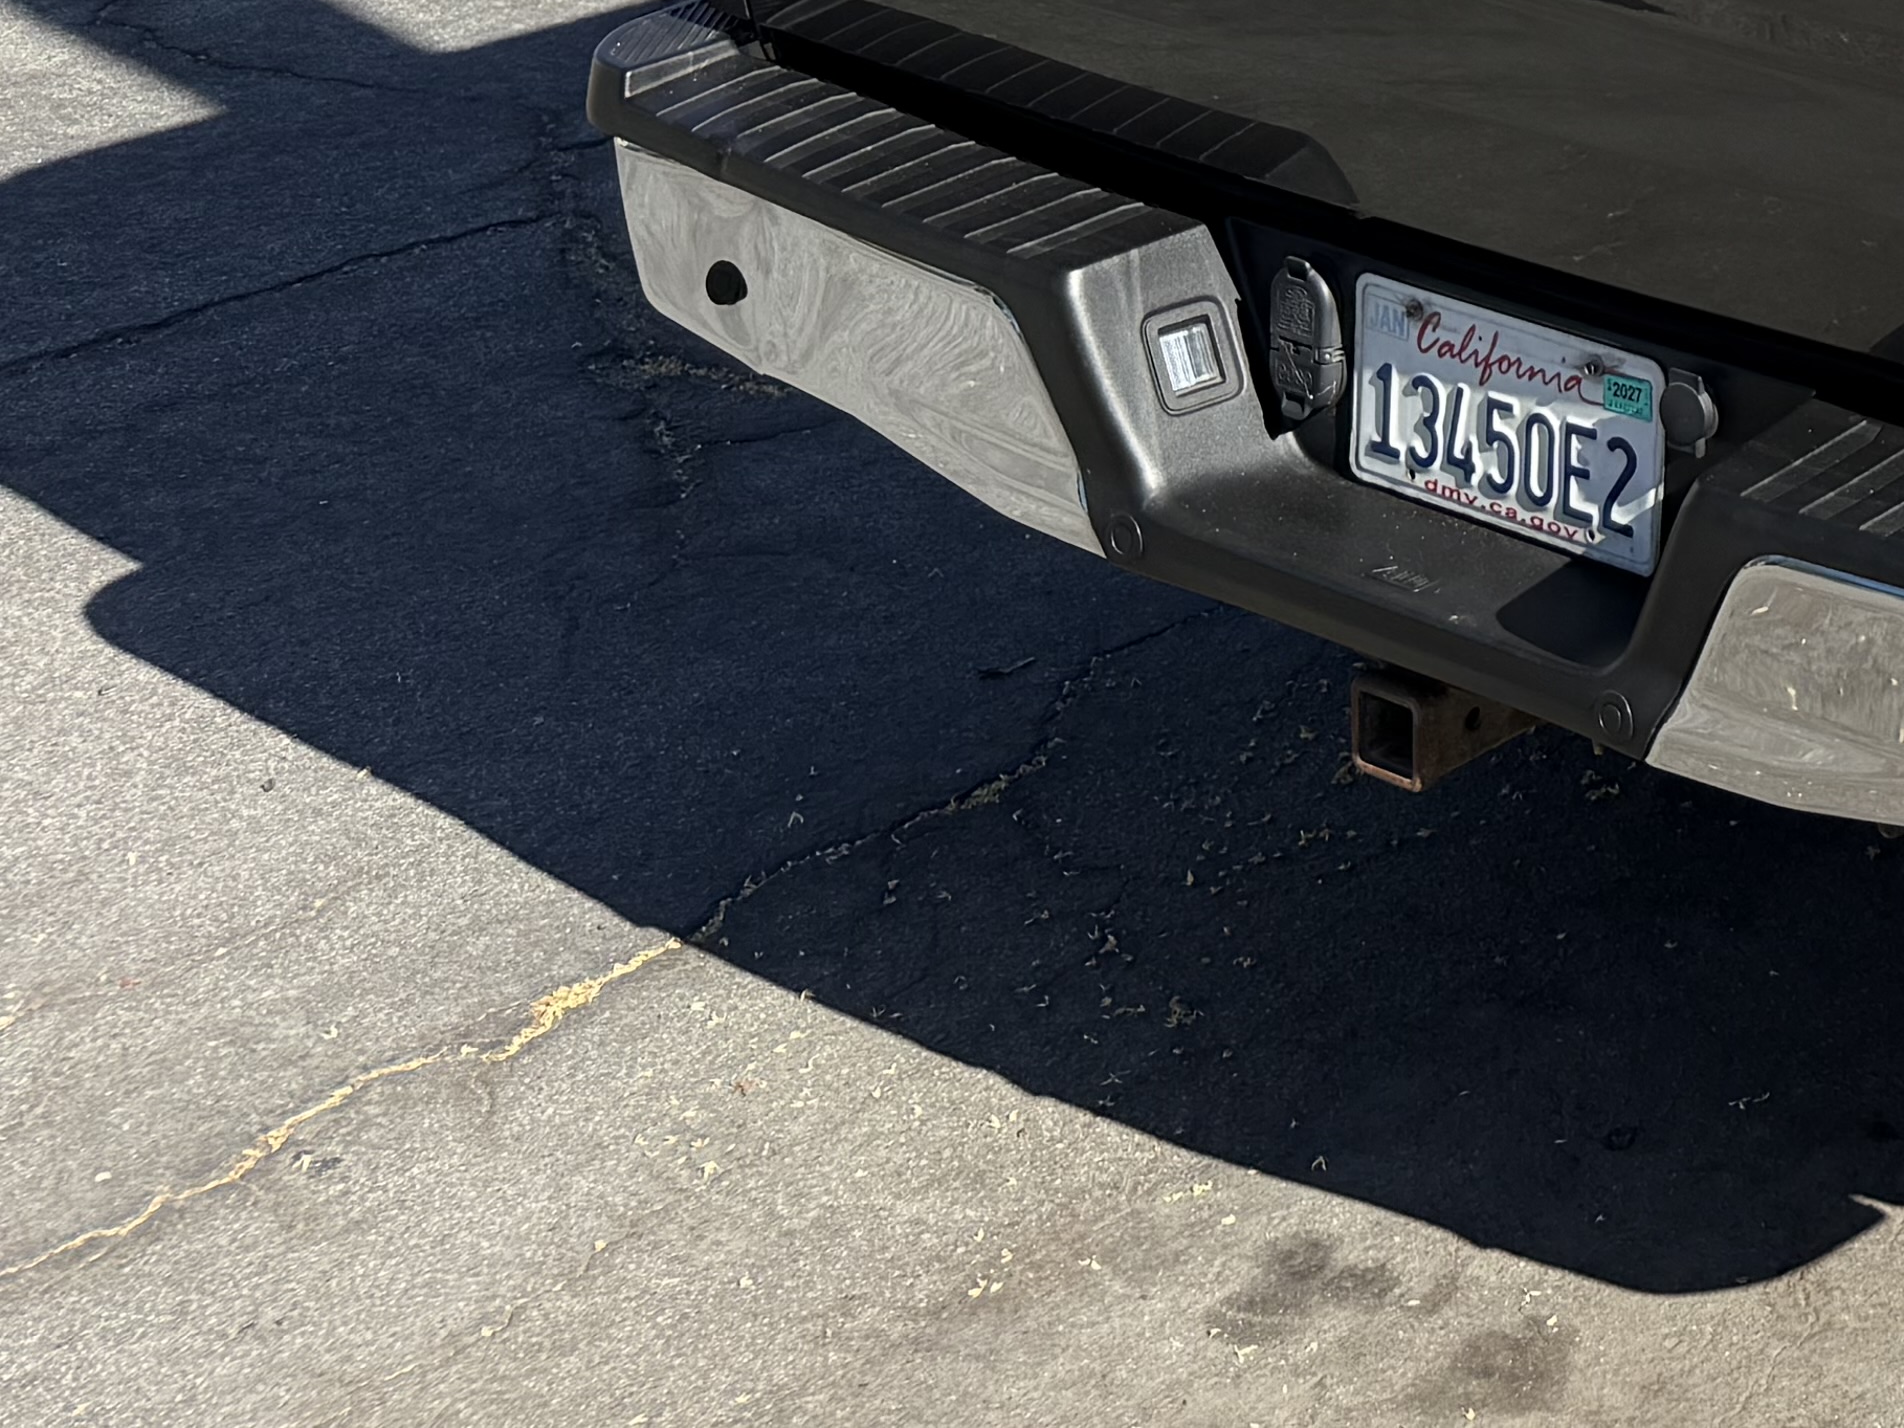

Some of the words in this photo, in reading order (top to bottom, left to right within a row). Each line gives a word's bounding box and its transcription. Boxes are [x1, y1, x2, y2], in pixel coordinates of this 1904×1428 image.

[1369, 301, 1407, 338] JAN
[1416, 311, 1602, 405] California
[1612, 381, 1643, 404] 2027
[1368, 361, 1636, 539] 13450E2
[1423, 477, 1580, 542] dmv.ca.gov
